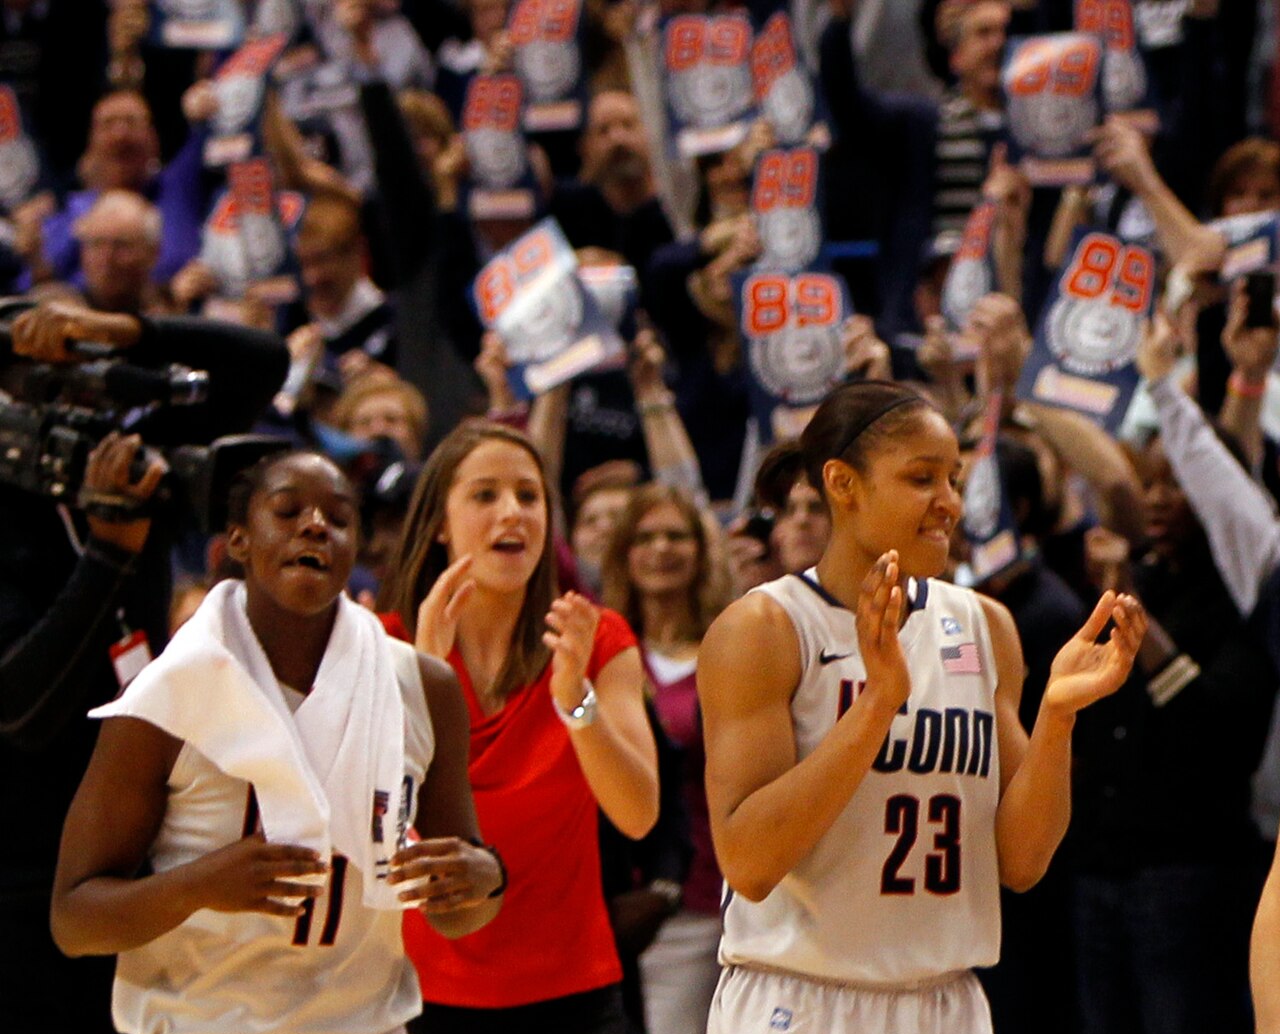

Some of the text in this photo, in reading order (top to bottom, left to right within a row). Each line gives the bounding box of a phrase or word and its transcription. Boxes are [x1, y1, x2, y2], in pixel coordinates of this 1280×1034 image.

[666, 13, 752, 71] 89
[754, 147, 819, 212] 89
[742, 273, 842, 337] 89
[1064, 232, 1155, 313] 89
[880, 794, 961, 895] 23
